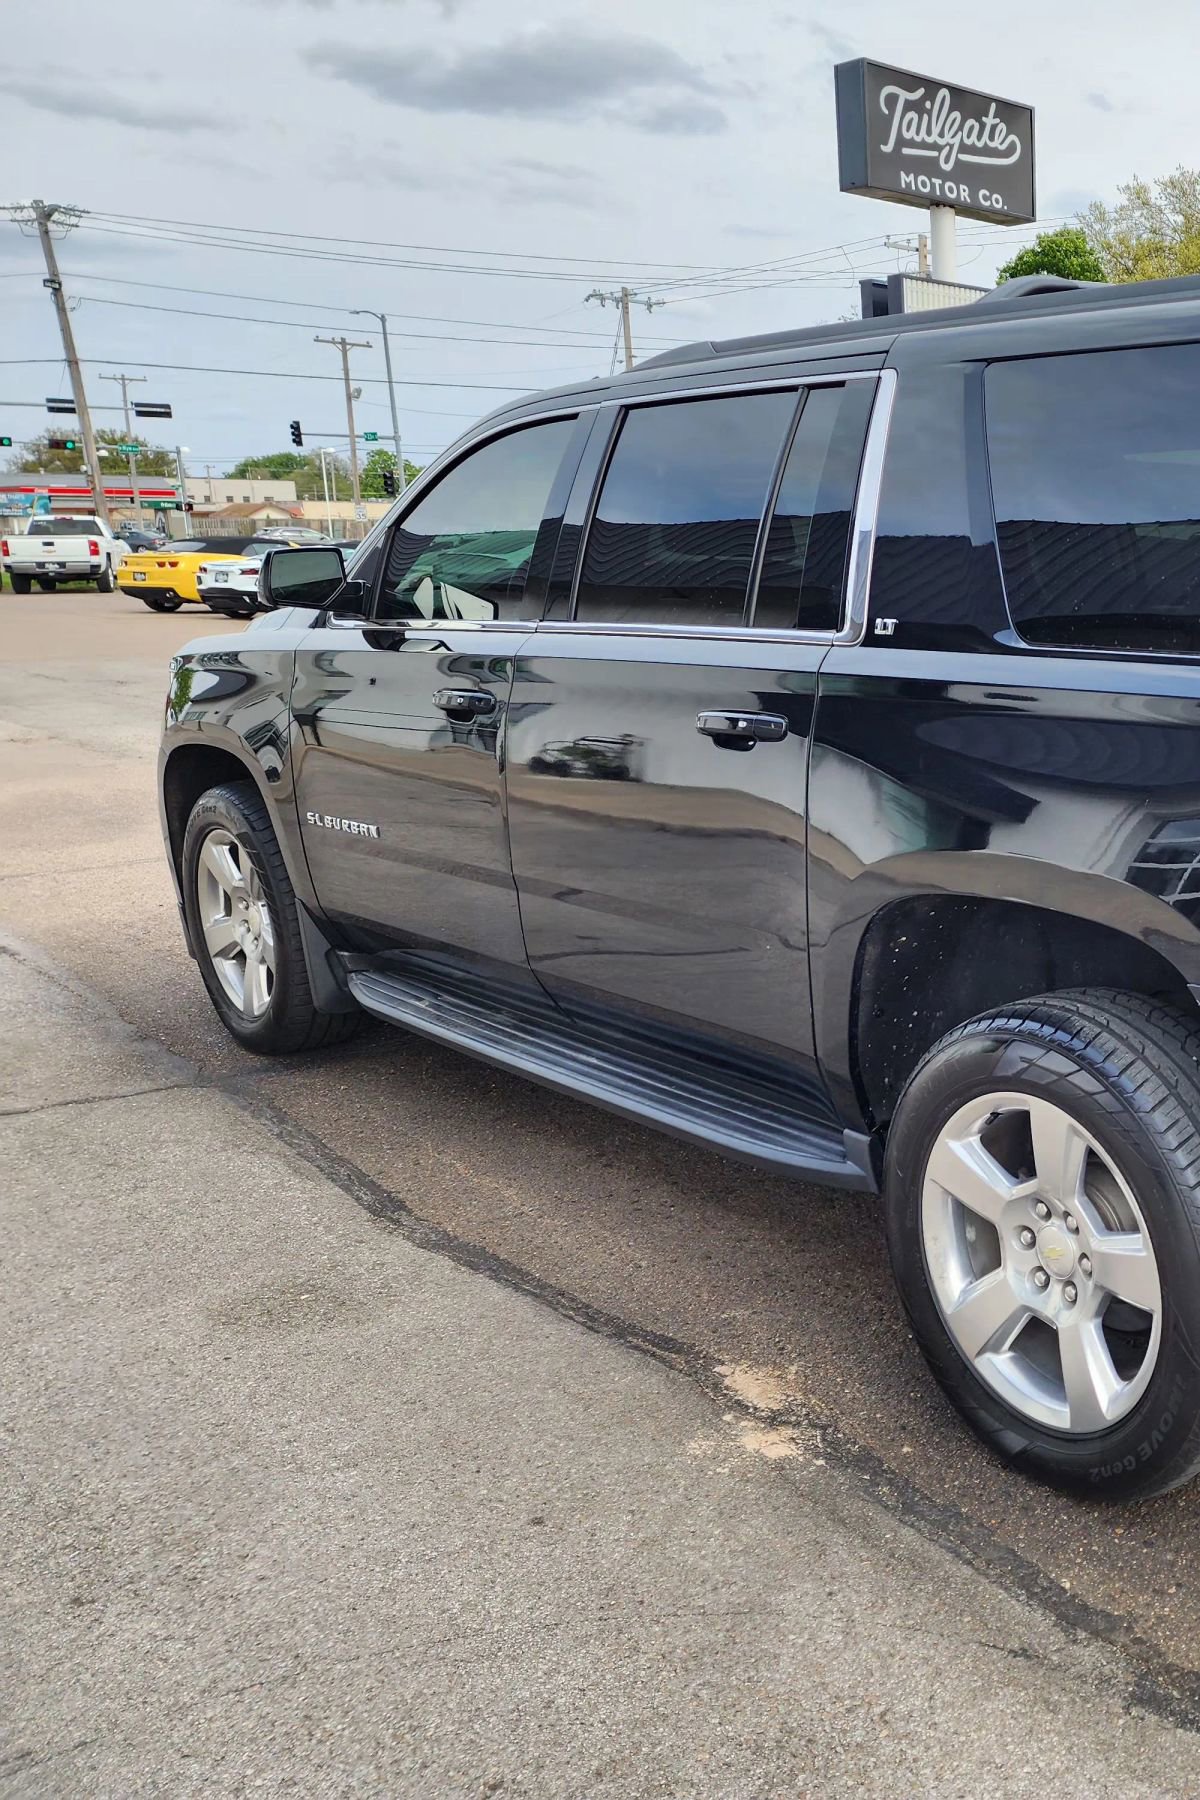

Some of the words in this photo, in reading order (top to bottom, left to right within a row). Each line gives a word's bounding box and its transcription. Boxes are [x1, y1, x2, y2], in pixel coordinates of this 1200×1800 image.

[879, 84, 1022, 172] Tailgate
[900, 170, 971, 203] MOTOR
[874, 618, 899, 635] LT
